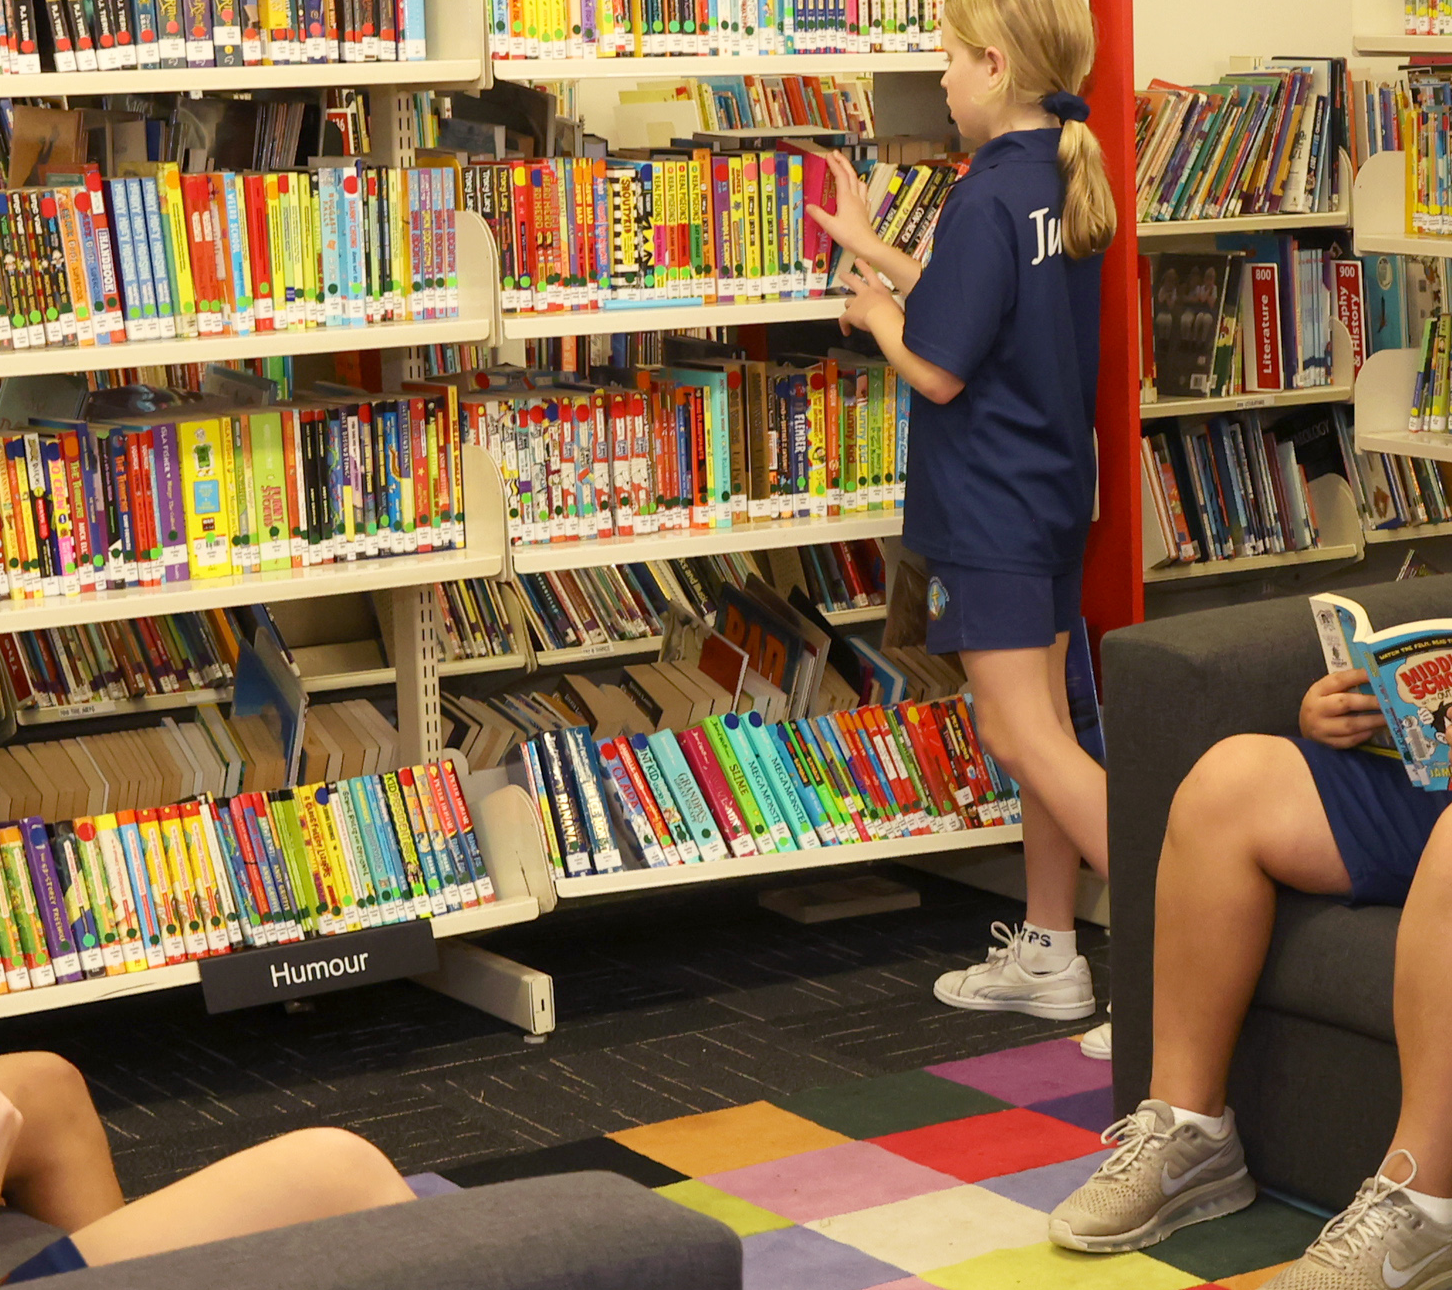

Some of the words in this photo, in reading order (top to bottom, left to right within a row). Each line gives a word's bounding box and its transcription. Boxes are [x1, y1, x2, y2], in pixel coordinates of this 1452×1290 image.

[100, 236, 116, 293] HANDBOOK
[1255, 267, 1271, 281] 800
[1339, 266, 1356, 279] 900
[1262, 293, 1273, 375] Literature
[1350, 292, 1363, 352] History
[386, 776, 398, 792] KID
[728, 764, 750, 796] SLIME
[268, 952, 370, 988] Humour
